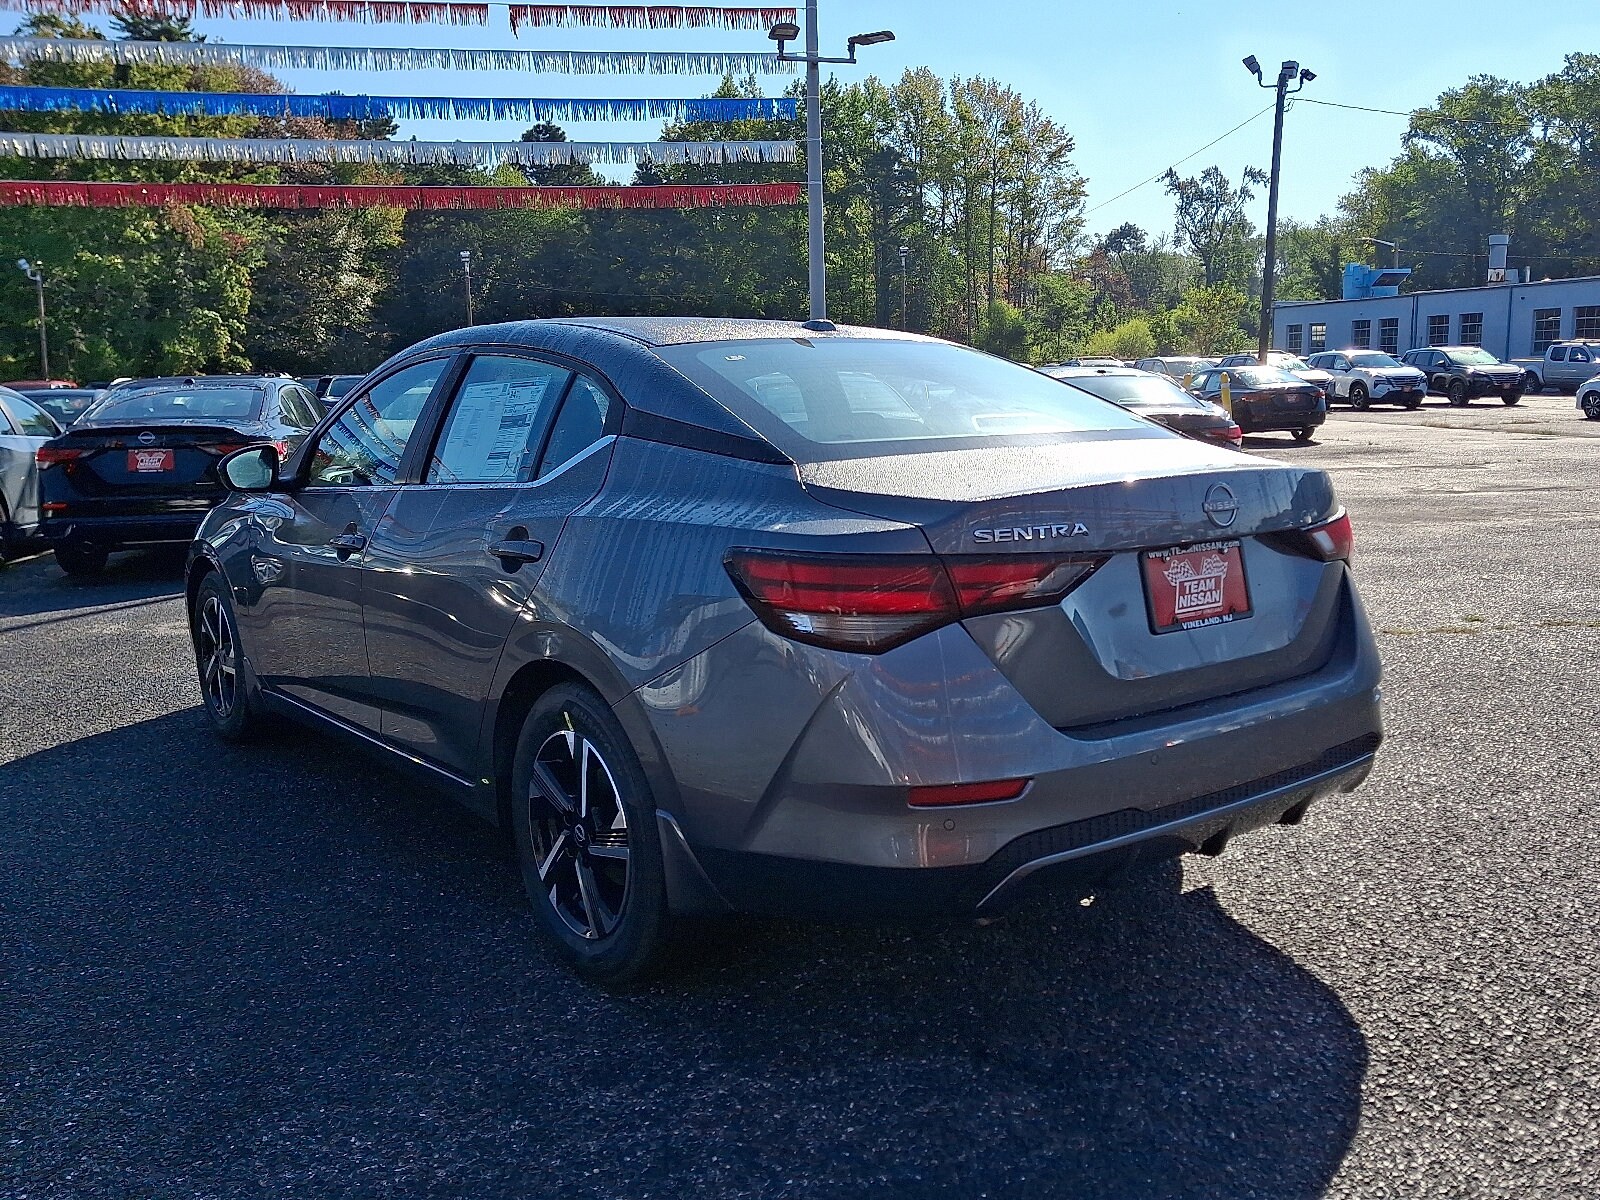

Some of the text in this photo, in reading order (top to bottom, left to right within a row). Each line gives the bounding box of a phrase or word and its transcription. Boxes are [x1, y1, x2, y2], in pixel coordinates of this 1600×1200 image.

[974, 523, 1089, 543] SENTRA
[1184, 578, 1215, 593] TEAM
[1178, 590, 1220, 608] NISSAN
[1223, 614, 1233, 622] NJ
